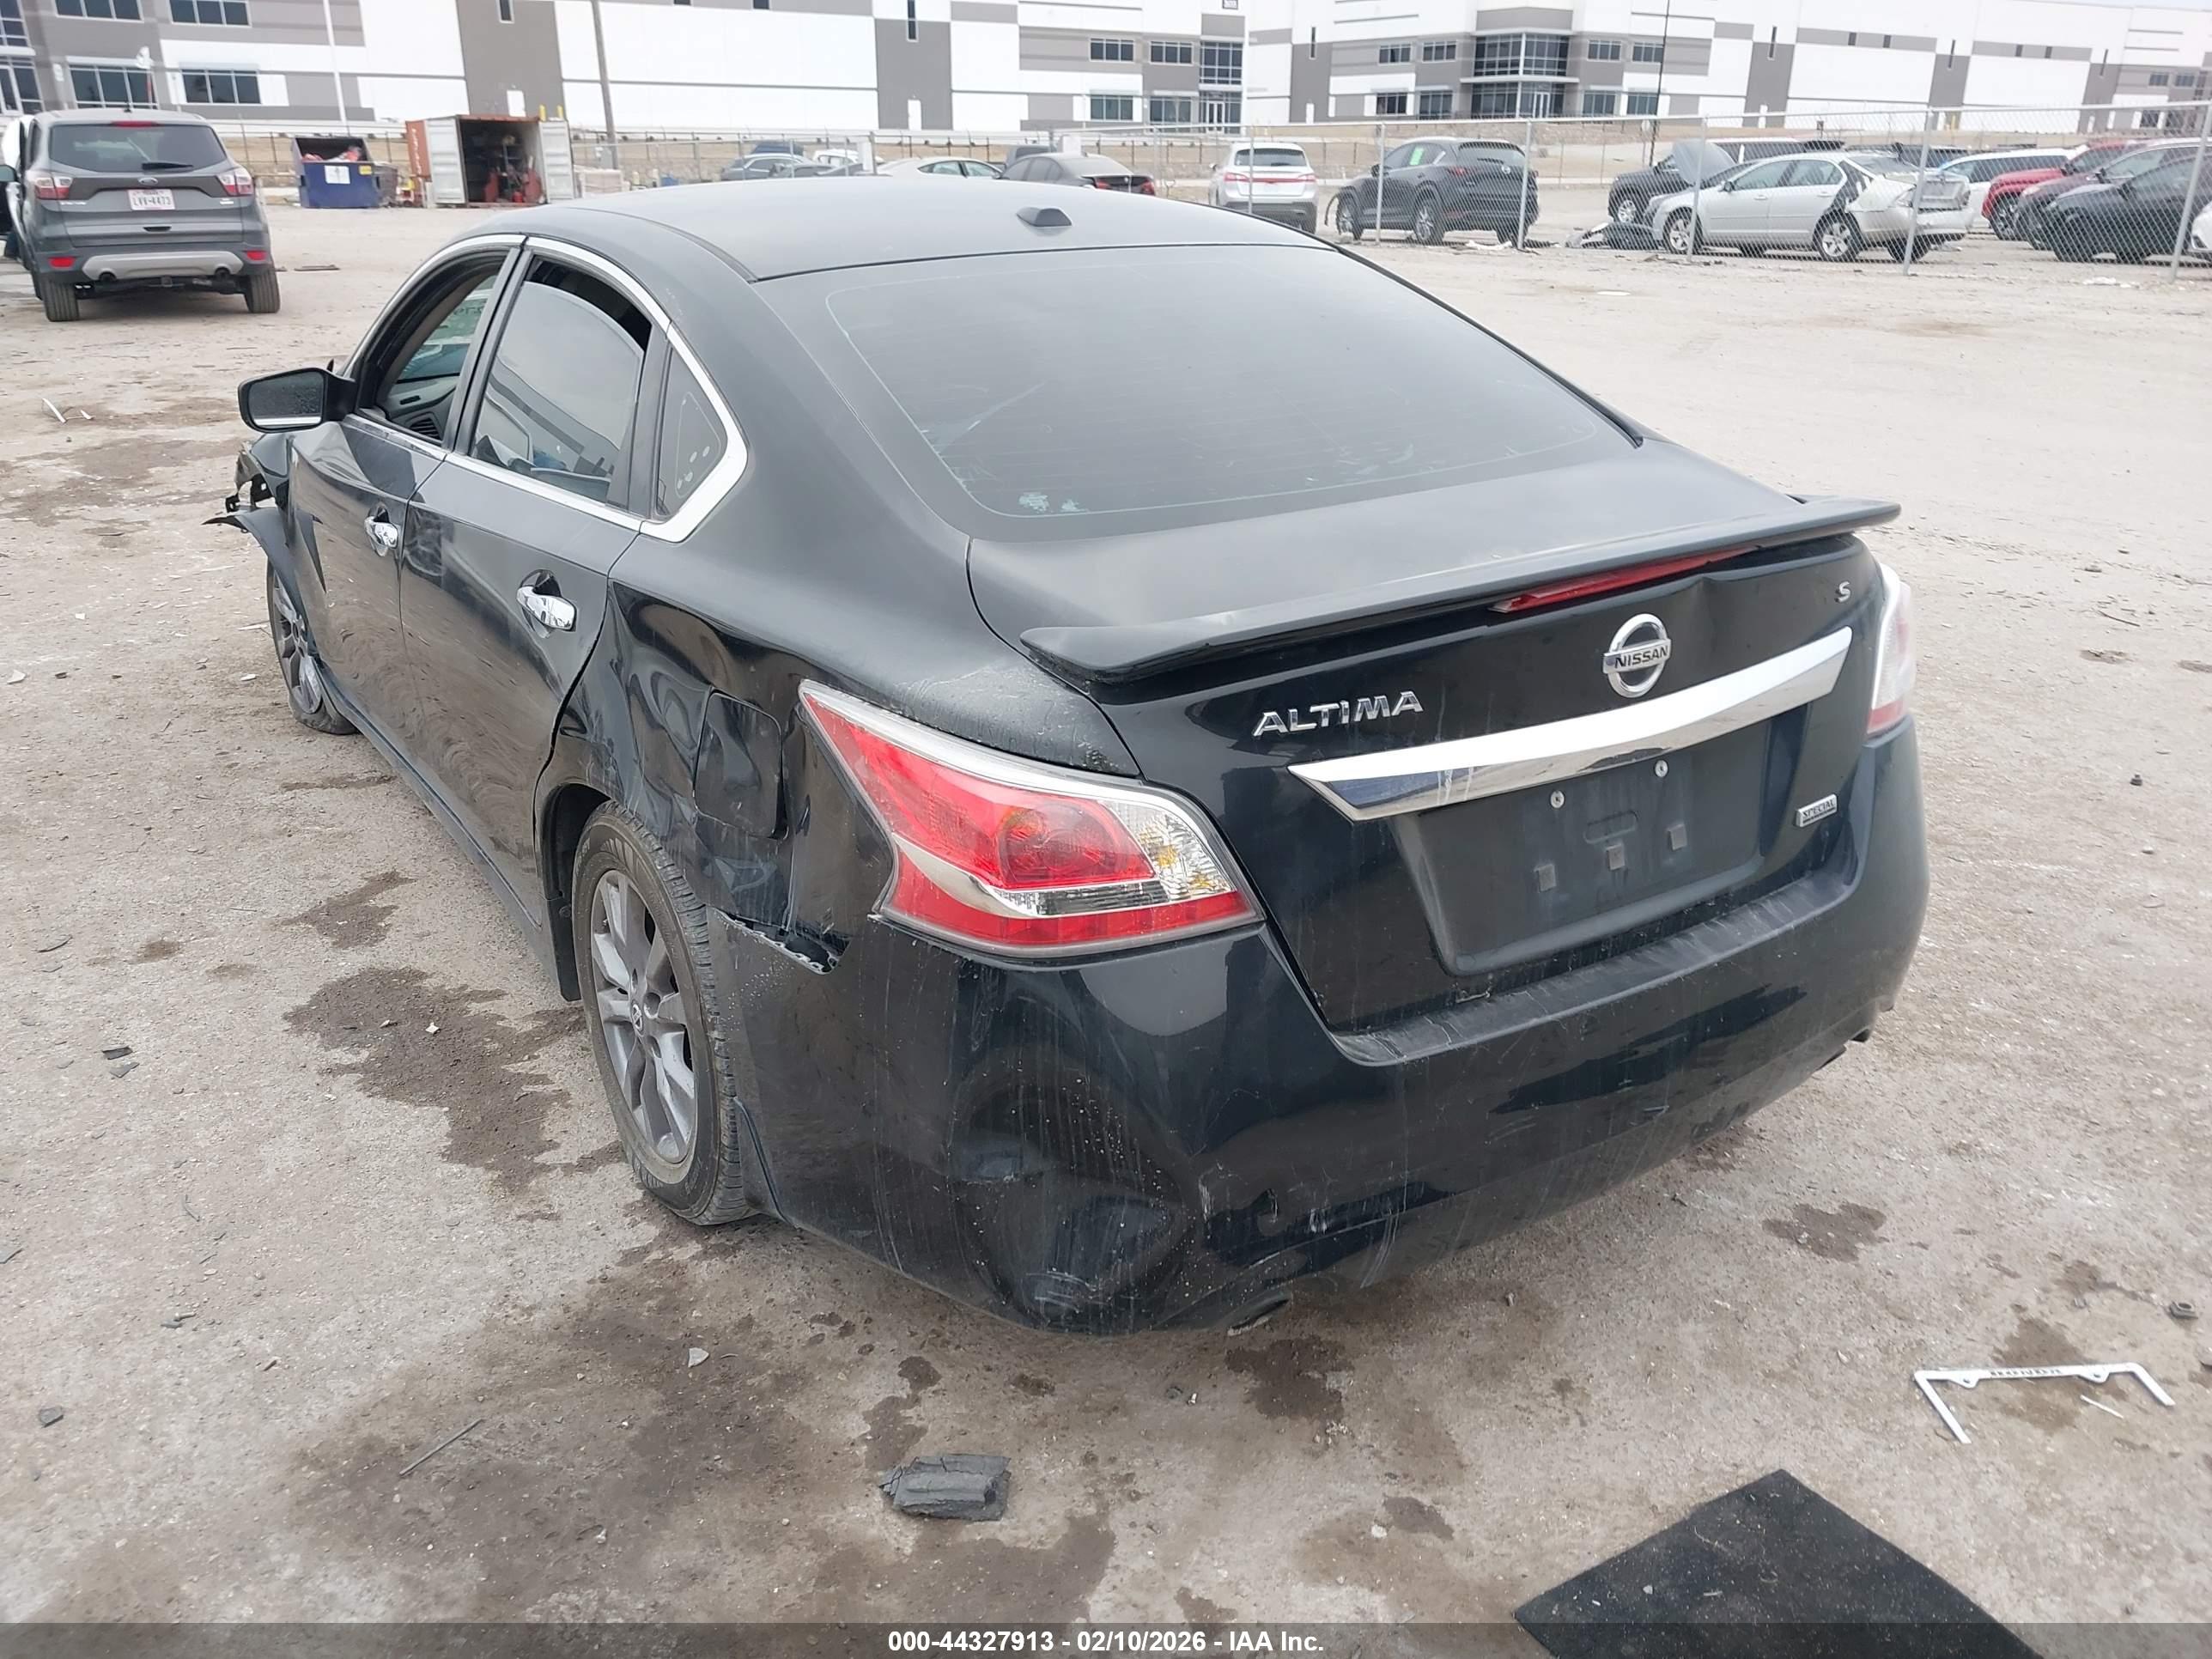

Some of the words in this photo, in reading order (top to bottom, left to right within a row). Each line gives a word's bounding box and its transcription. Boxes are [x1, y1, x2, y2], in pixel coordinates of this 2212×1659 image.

[1838, 580, 1851, 603] S
[1614, 645, 1668, 669] NISSAN
[1253, 690, 1424, 737] ALTIMA
[1802, 798, 1836, 819] SPECIAL
